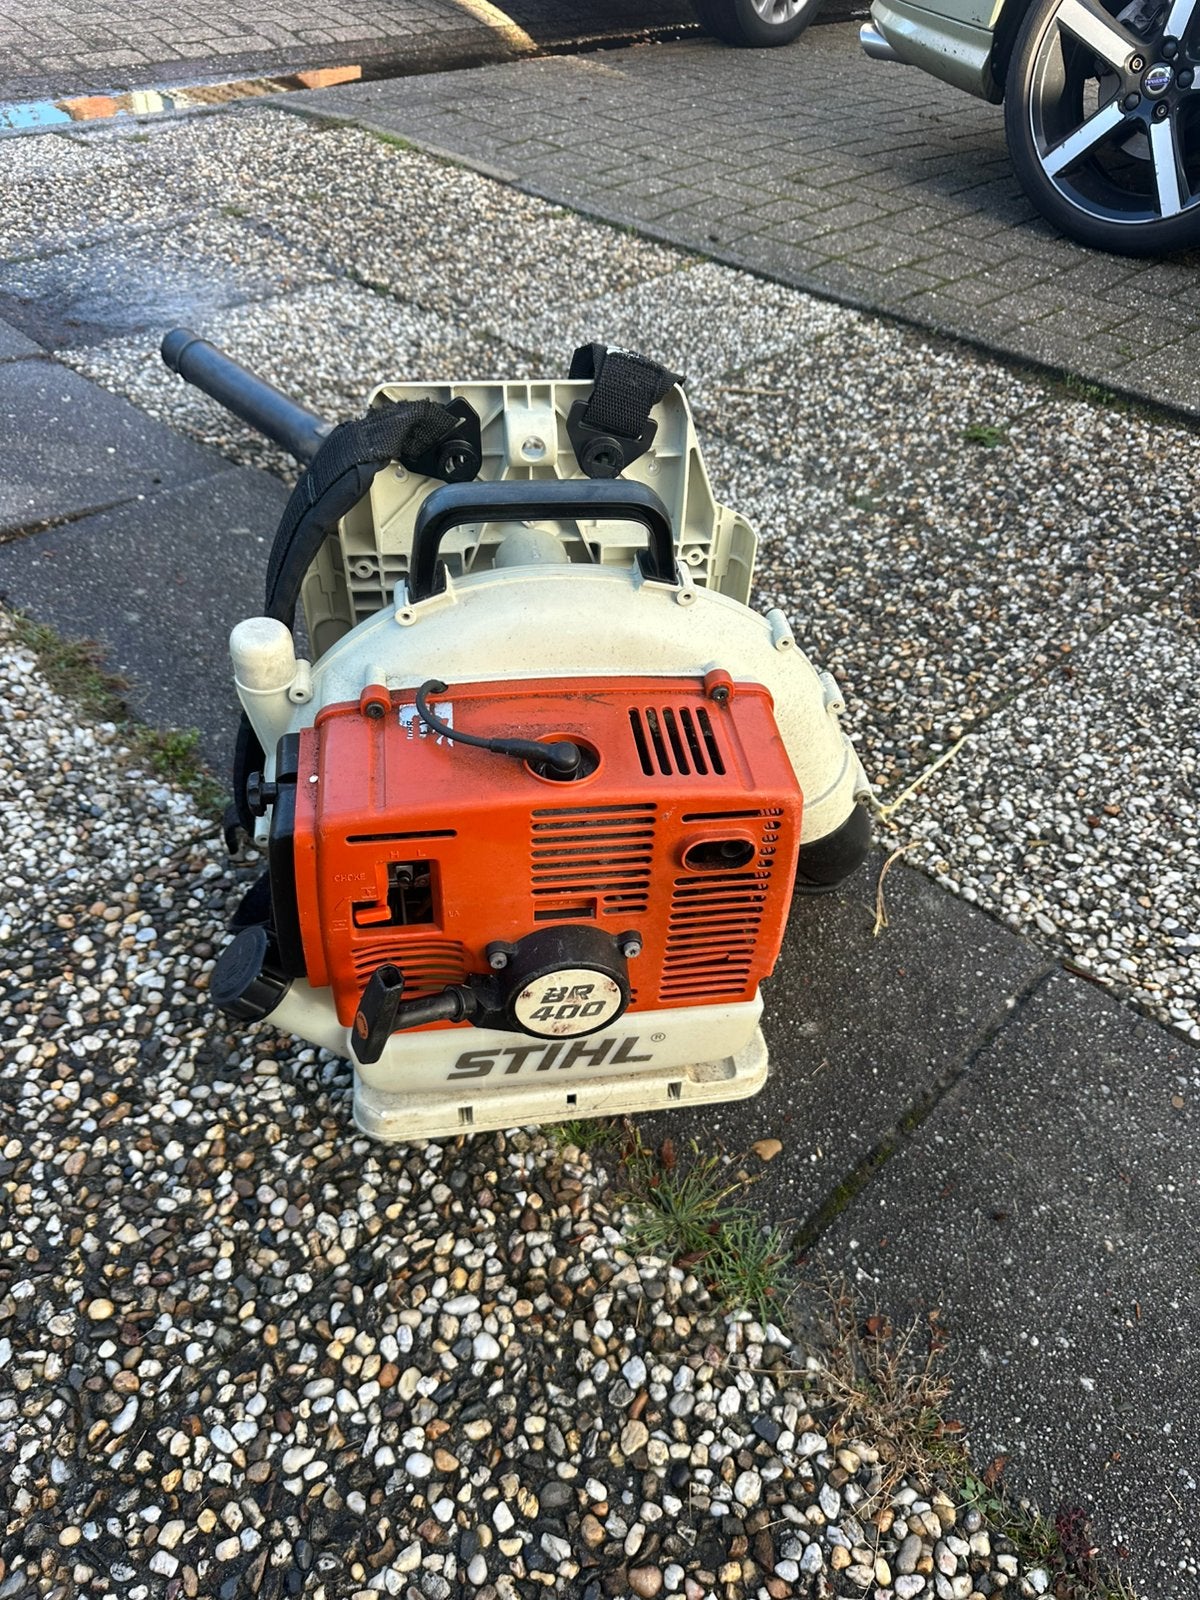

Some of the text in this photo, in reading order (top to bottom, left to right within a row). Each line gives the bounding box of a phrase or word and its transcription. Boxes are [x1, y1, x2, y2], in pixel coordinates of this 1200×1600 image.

[389, 849, 427, 859] H L
[334, 872, 367, 882] CHOKE
[540, 983, 595, 1004] BR
[529, 1000, 607, 1021] 400
[446, 1036, 654, 1080] STIHL
